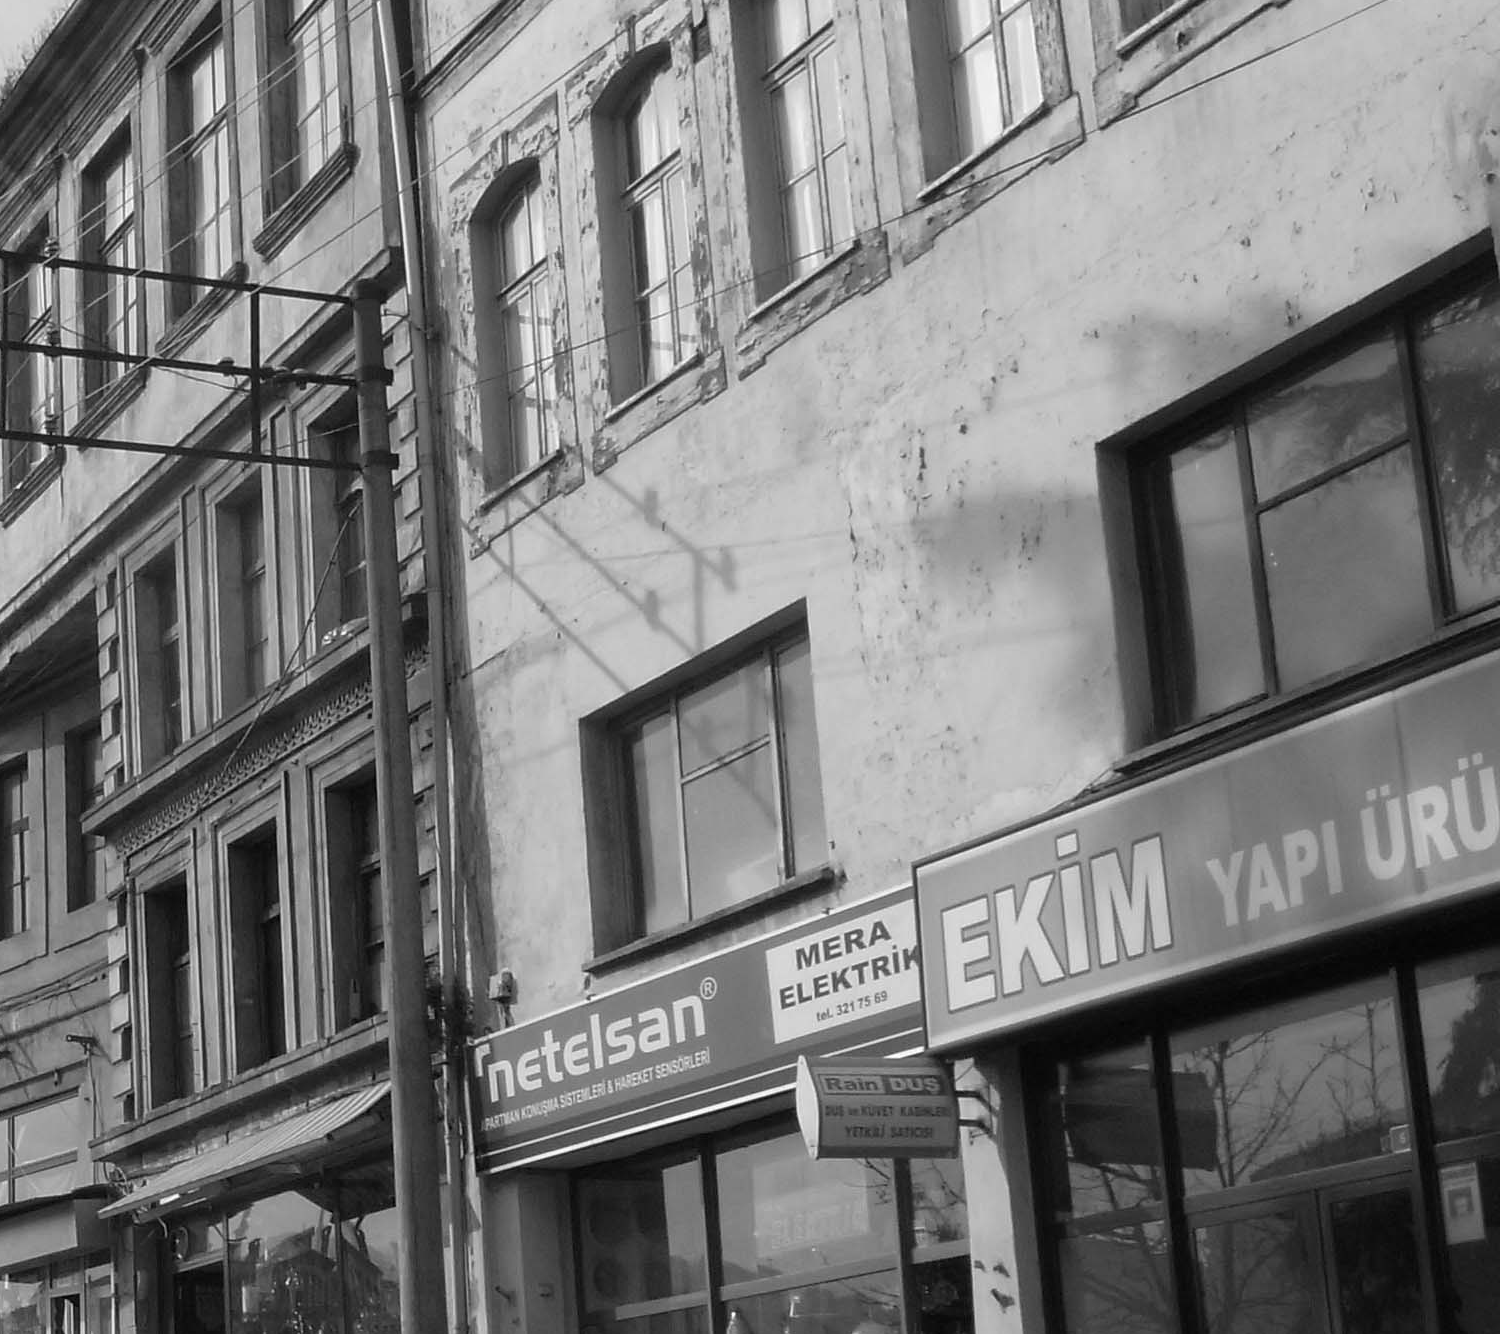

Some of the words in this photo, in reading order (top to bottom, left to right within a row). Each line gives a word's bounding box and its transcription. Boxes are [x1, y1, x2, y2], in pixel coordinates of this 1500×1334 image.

[941, 830, 1173, 1013] EKİM
[1206, 820, 1343, 926] YAPI
[795, 920, 892, 971] MERA
[779, 944, 921, 1010] ELEKTRİK
[837, 1001, 855, 1016] 321
[857, 995, 871, 1009] 75
[874, 990, 888, 1004] 69
[824, 1077, 878, 1092] Rain
[888, 1077, 941, 1095] DUŞ
